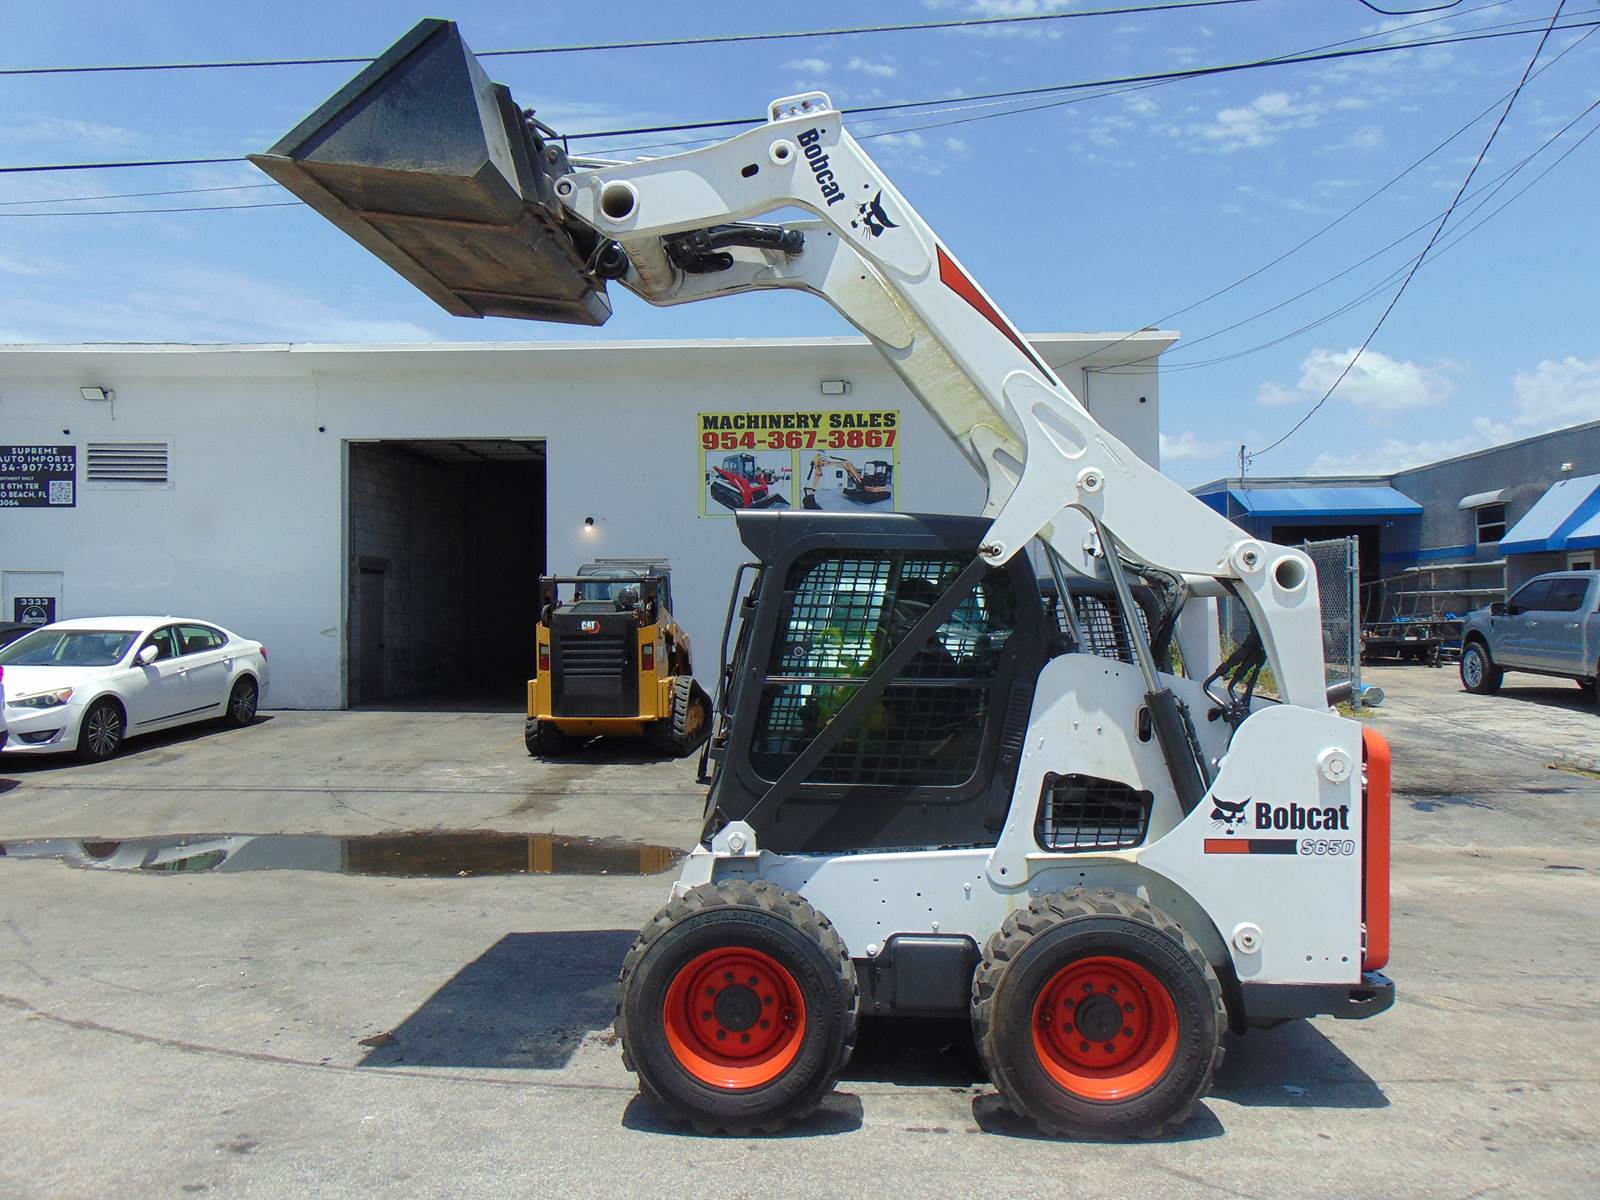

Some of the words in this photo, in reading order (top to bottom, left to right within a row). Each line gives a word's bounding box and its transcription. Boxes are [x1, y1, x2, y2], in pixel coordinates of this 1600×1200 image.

[796, 127, 846, 207] Bobcat
[702, 413, 823, 430] MACHINERY
[829, 412, 897, 429] SALES
[702, 429, 897, 450] 954-367-3867
[11, 447, 58, 455] SUPREME
[27, 455, 73, 463] IMPORTS
[1, 463, 75, 472] 54-907-7527
[9, 491, 37, 499] BEACH,
[581, 620, 596, 631] CAT
[1255, 802, 1350, 831] Bobcat
[1300, 838, 1355, 856] S650
